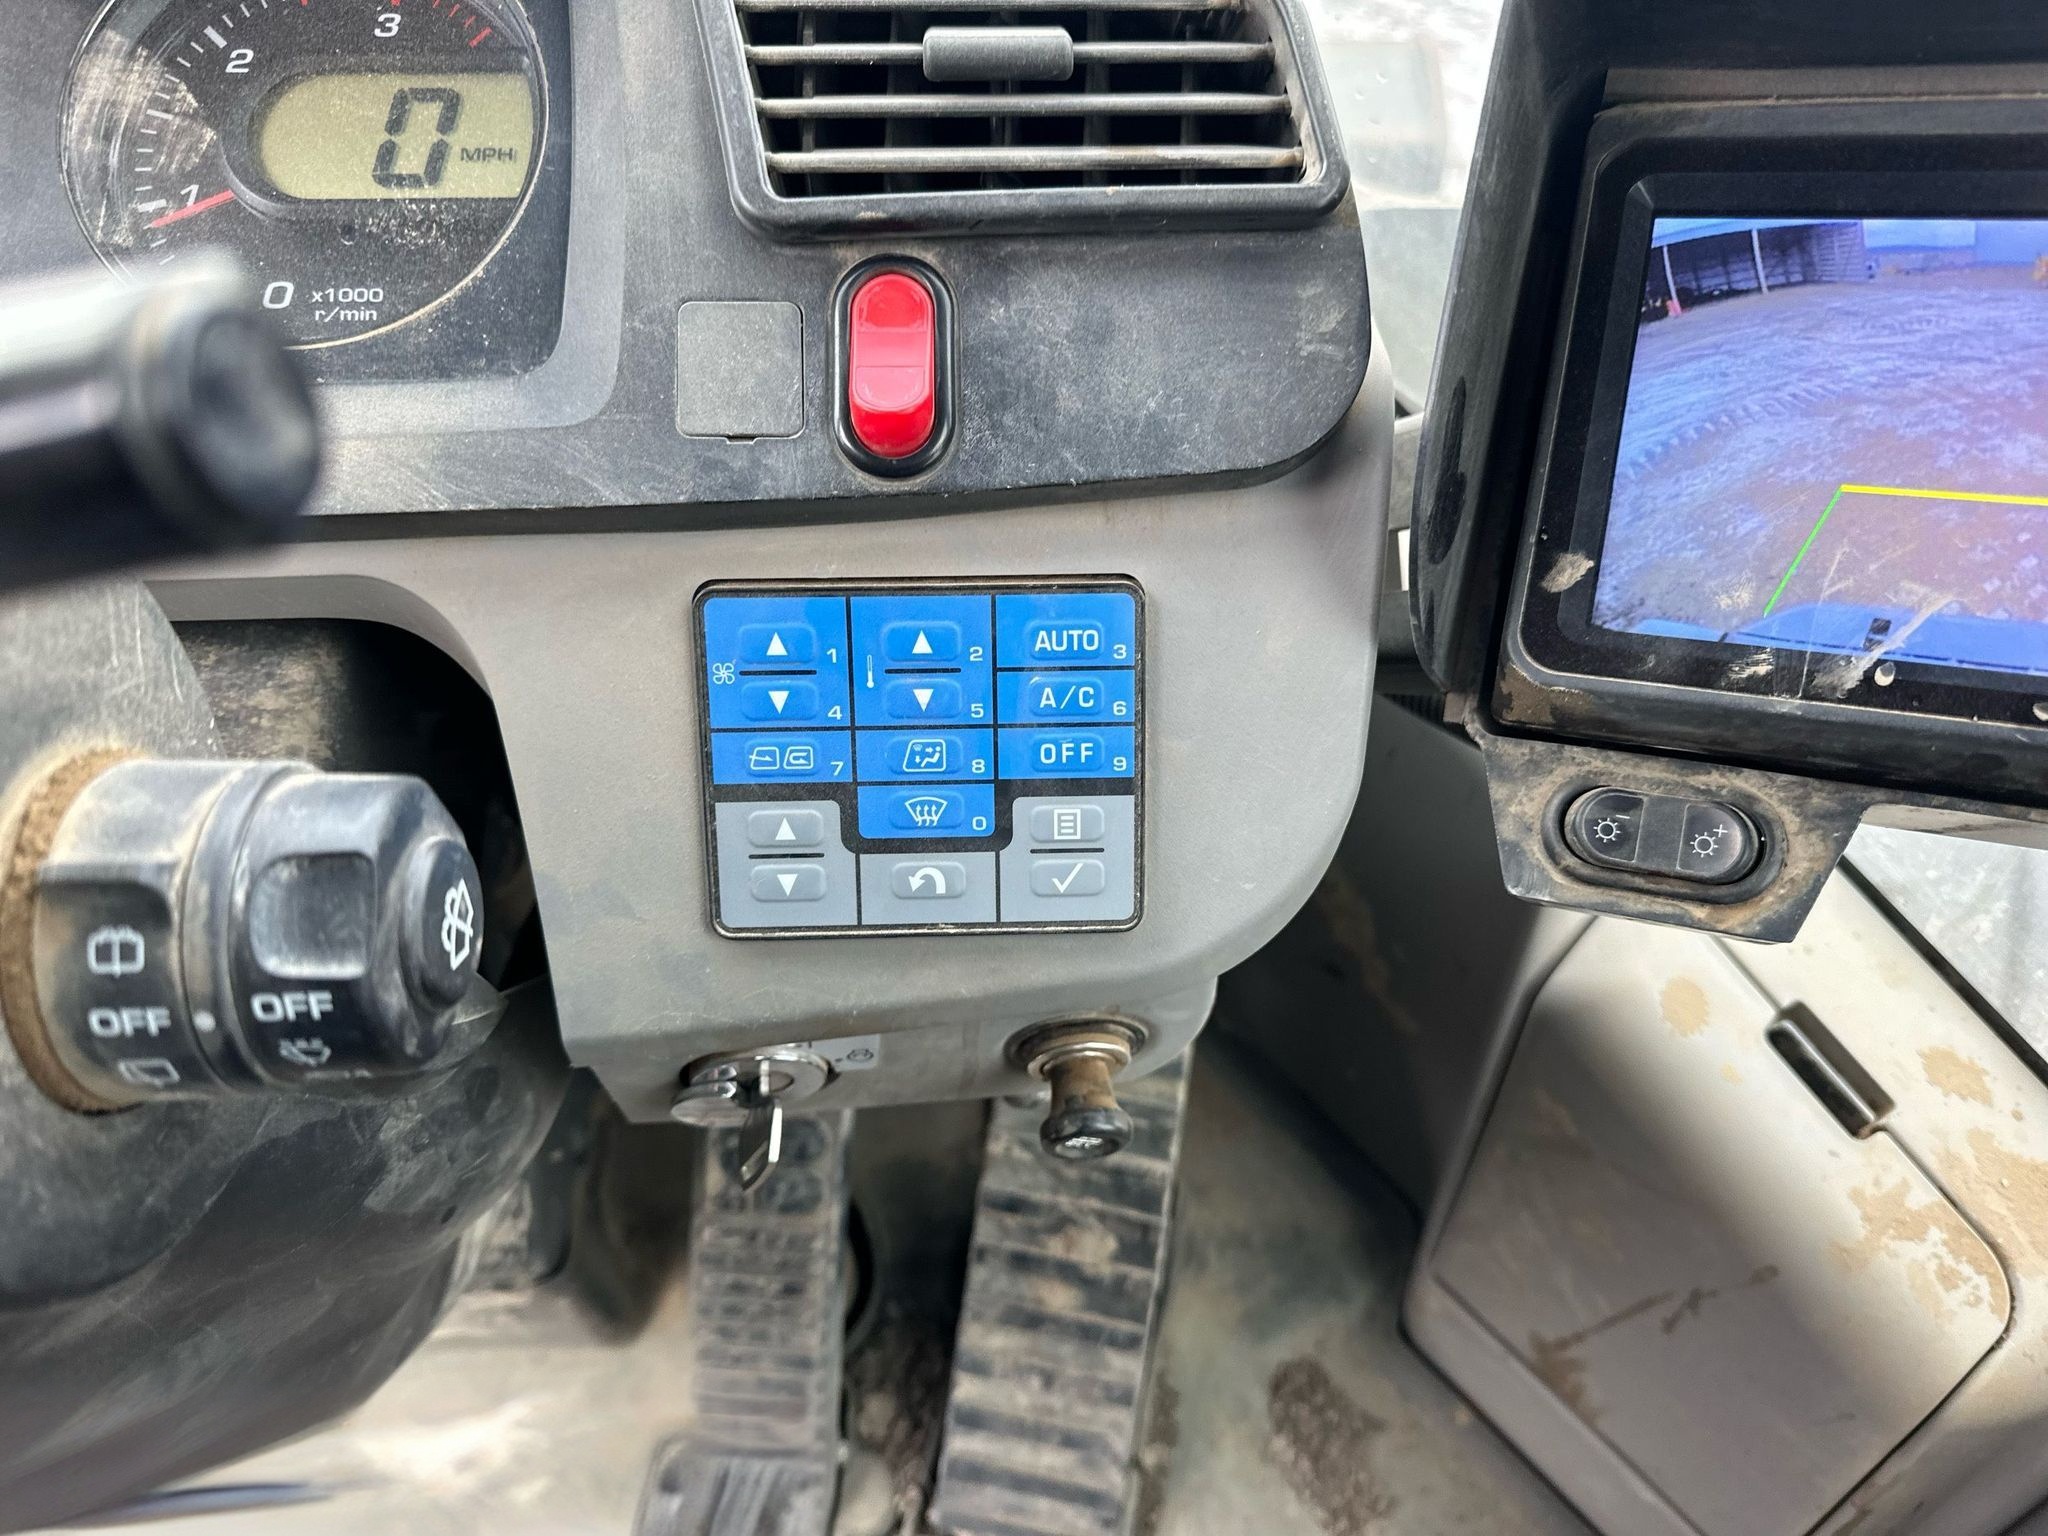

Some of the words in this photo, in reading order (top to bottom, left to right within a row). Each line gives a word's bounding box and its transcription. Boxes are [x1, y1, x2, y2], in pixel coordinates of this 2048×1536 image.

[374, 13, 401, 38] 3
[226, 48, 254, 73] 2
[372, 87, 461, 189] 0
[460, 146, 514, 163] MPH
[179, 184, 199, 206] 1
[262, 282, 294, 309] 0
[311, 287, 384, 304] x1000
[314, 306, 378, 323] r/min
[1034, 629, 1100, 652] AUTO
[826, 648, 837, 664] 1
[969, 646, 984, 662] 2
[1112, 644, 1128, 660] 3
[1039, 686, 1096, 709] A/C
[827, 705, 843, 721] 4
[970, 703, 985, 719] 5
[1112, 701, 1127, 716] 6
[1039, 742, 1095, 765] OFF
[830, 761, 845, 777] 7
[971, 759, 986, 774] 8
[1112, 757, 1127, 772] 9
[971, 816, 987, 831] 0
[251, 990, 334, 1023] OFF
[88, 1007, 171, 1038] OFF
